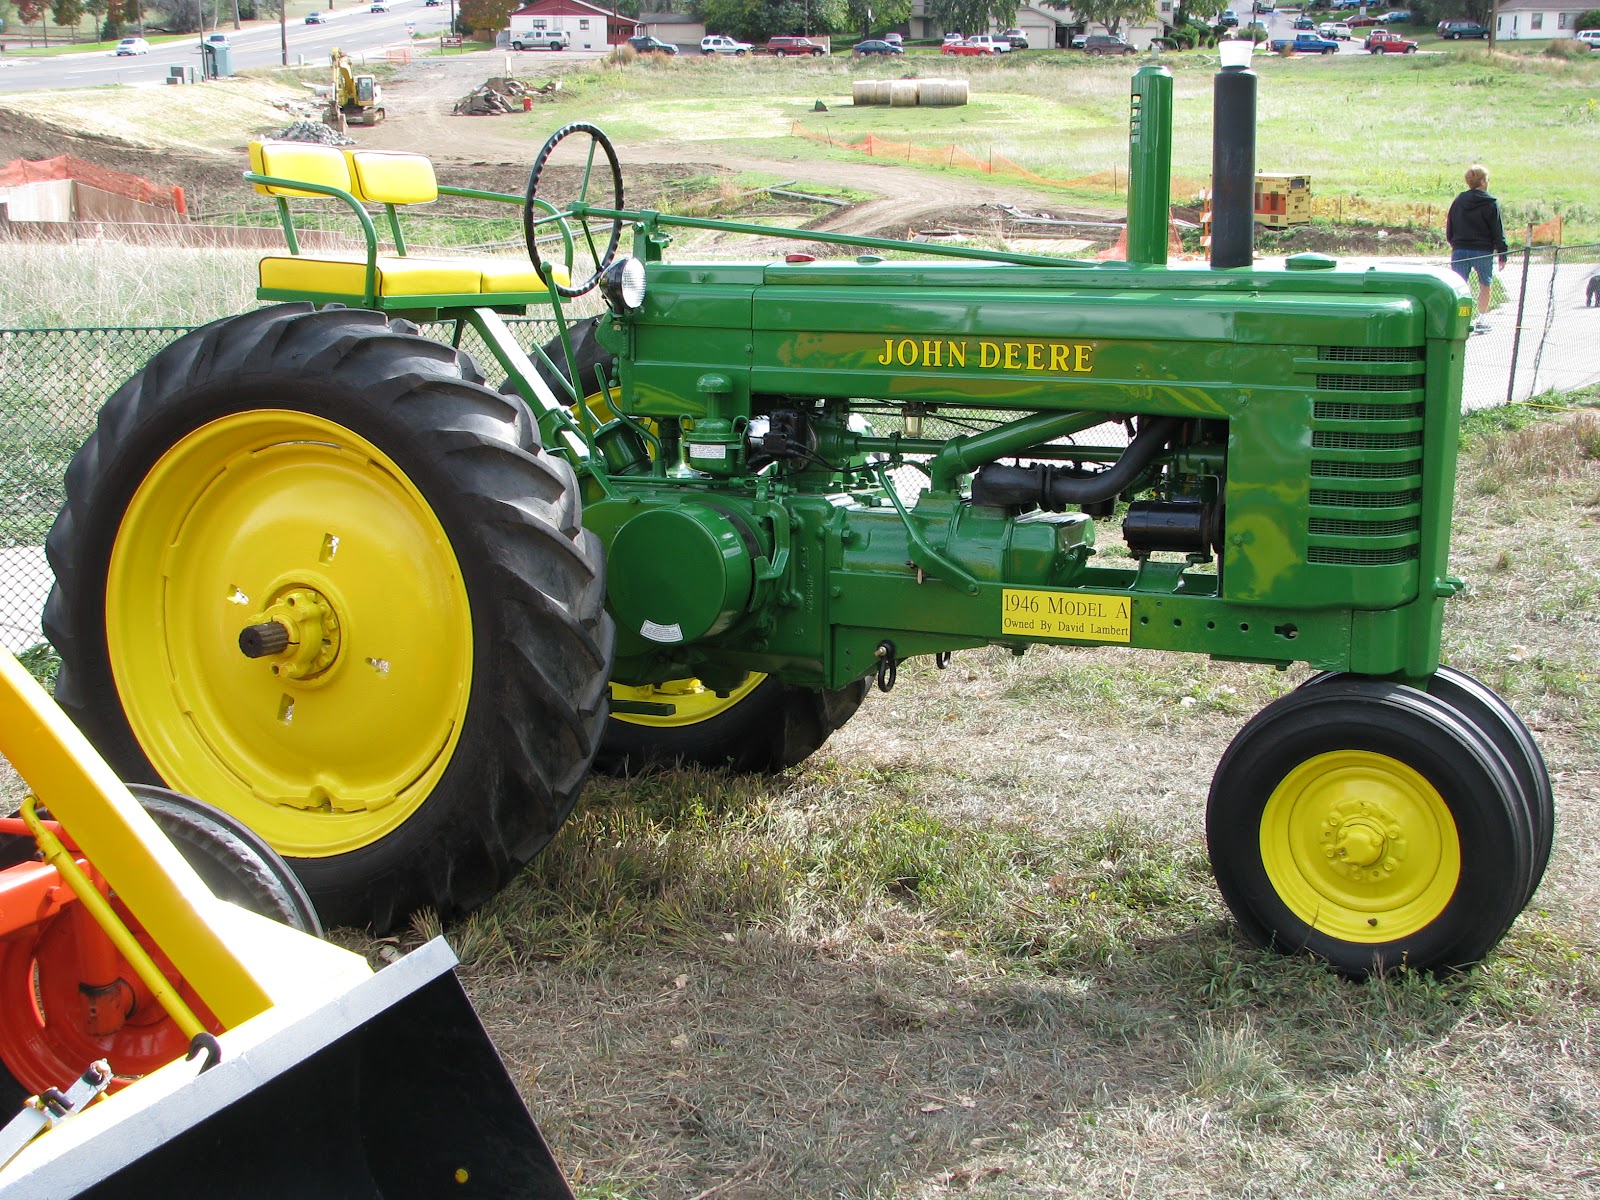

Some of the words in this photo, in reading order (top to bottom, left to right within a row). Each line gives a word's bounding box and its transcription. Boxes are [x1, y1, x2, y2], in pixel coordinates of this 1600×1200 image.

[878, 338, 967, 367] JOHN
[978, 341, 1093, 372] DEERE
[1004, 594, 1039, 614] 1946
[1048, 596, 1107, 618] MODEL
[1115, 601, 1128, 619] A
[1004, 617, 1035, 630] Owned
[1040, 620, 1052, 633] By
[1058, 621, 1085, 633] David
[1090, 623, 1128, 636] Lambert
